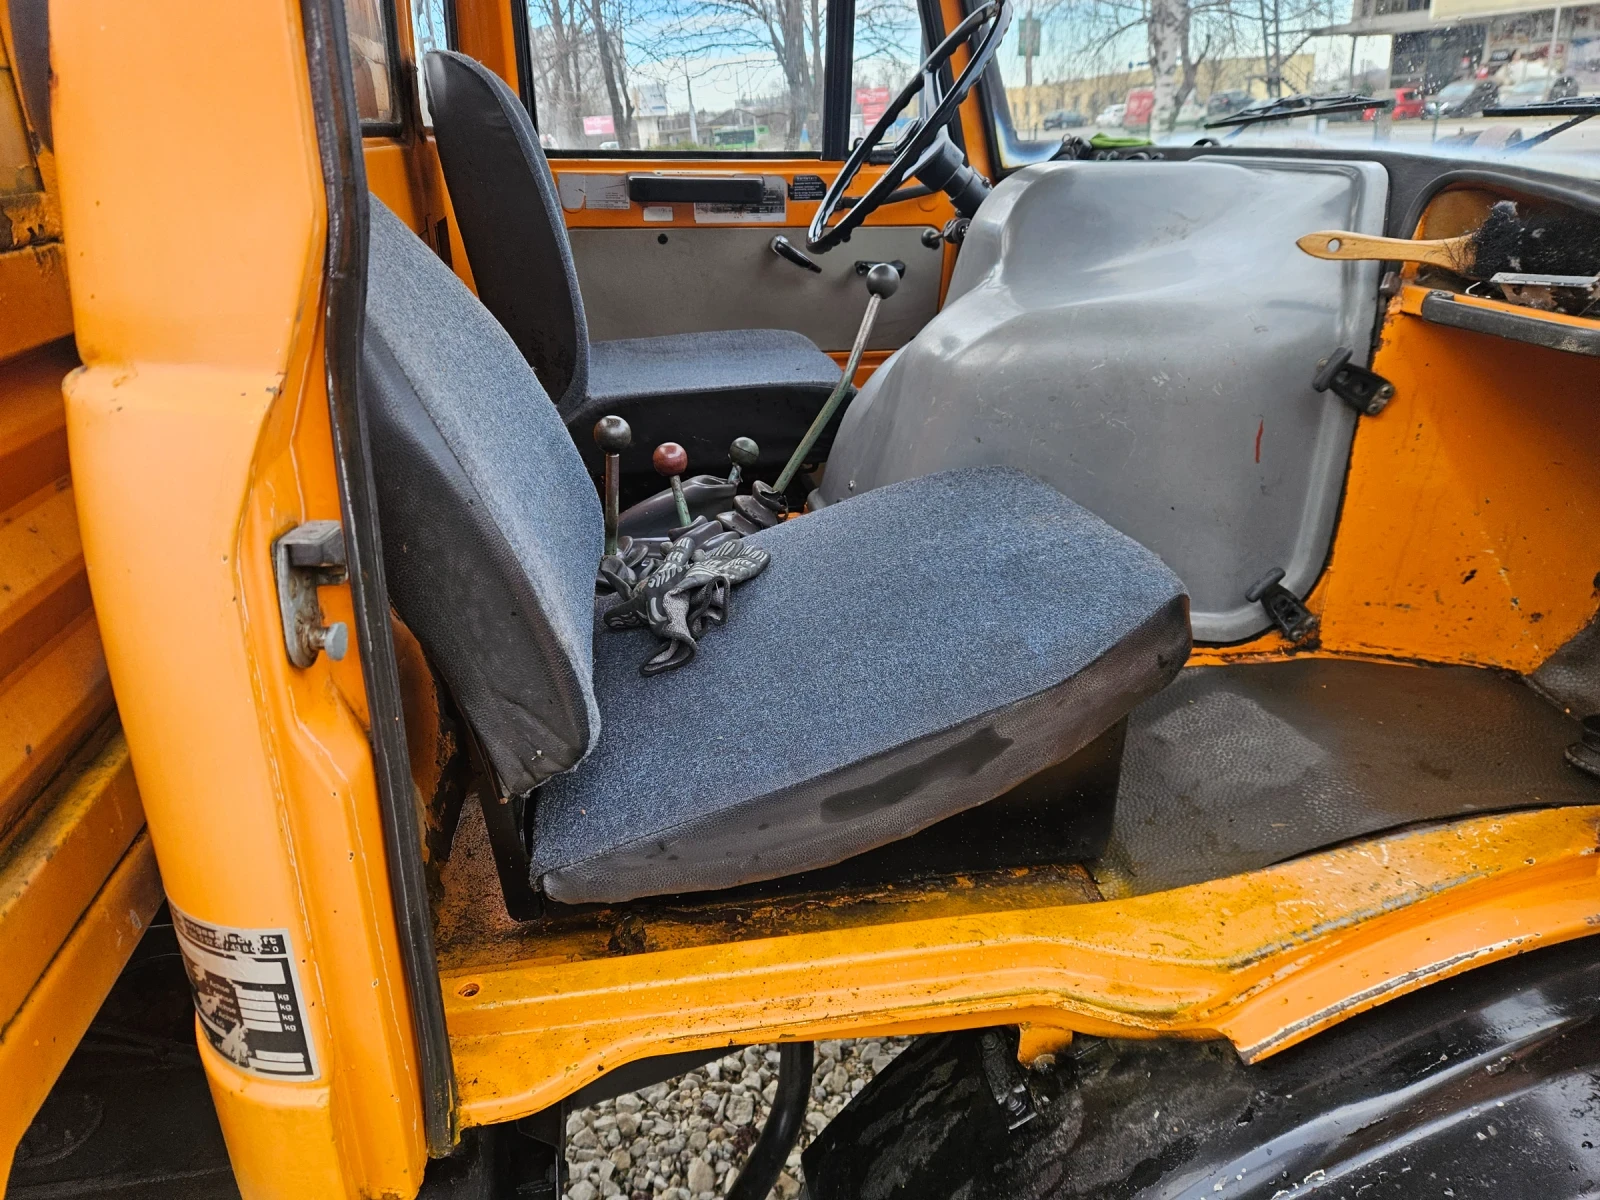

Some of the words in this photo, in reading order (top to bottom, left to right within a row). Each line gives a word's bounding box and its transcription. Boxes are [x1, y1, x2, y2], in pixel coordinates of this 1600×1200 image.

[277, 992, 290, 1001] kg
[279, 1003, 292, 1012] kg
[282, 1013, 295, 1022] kg
[284, 1023, 297, 1032] kg
